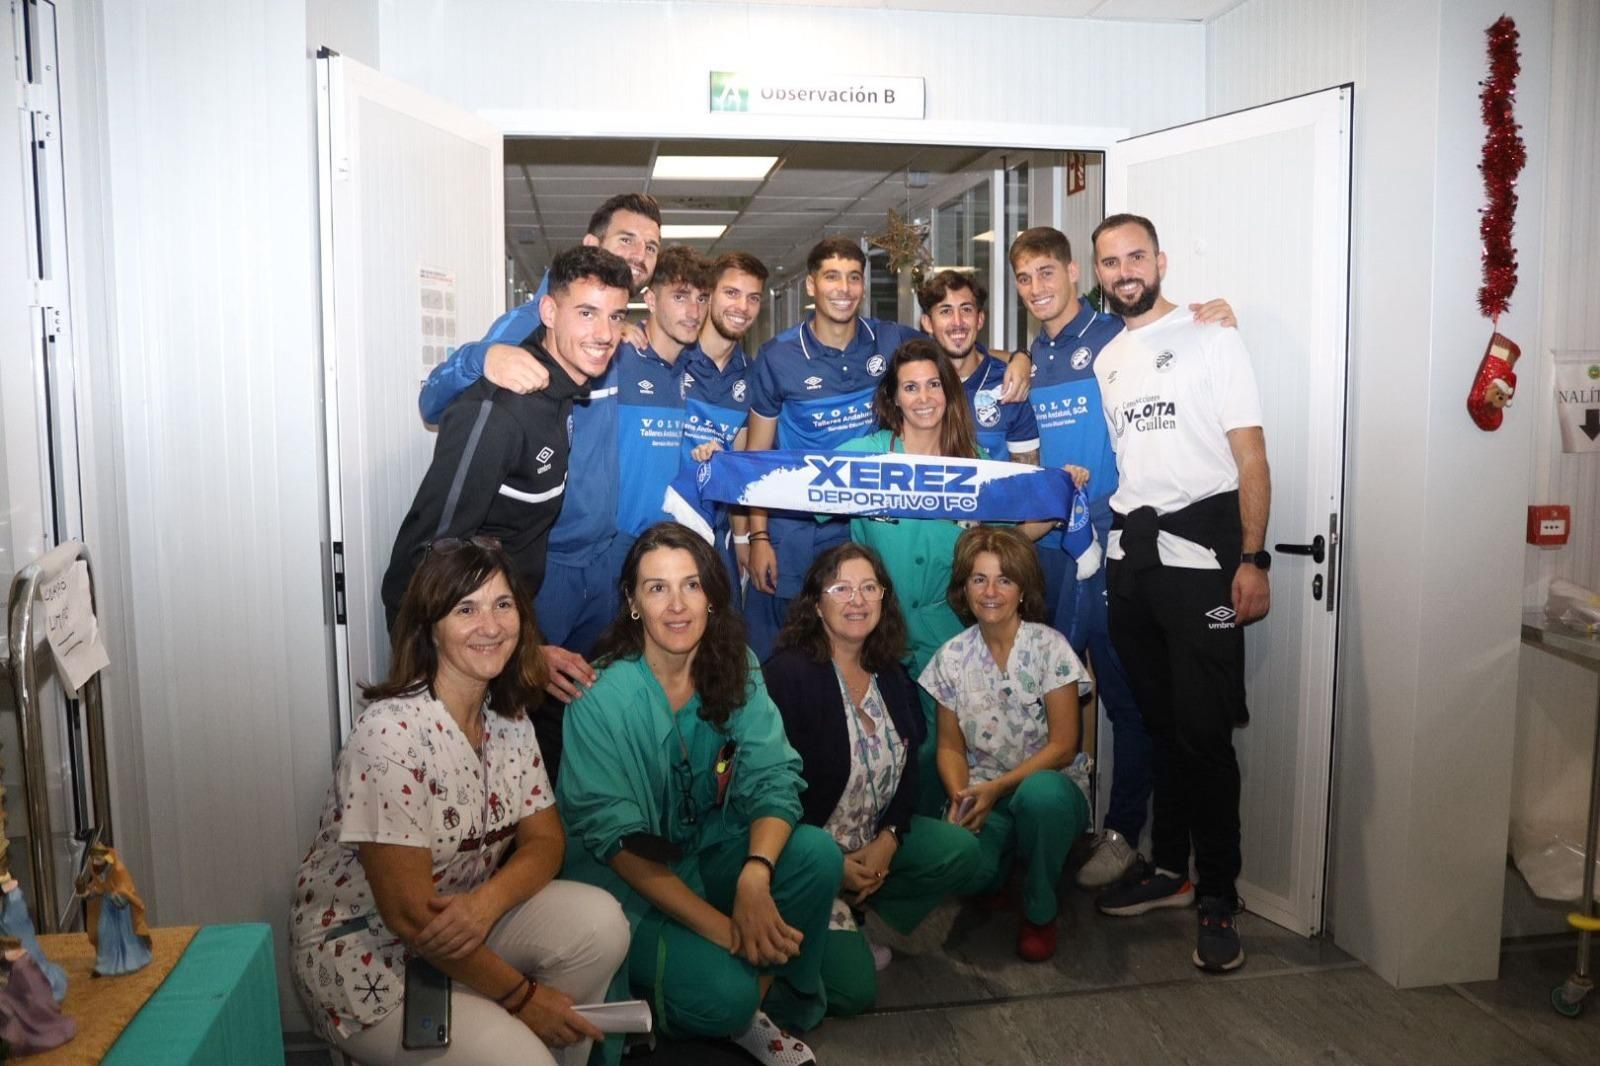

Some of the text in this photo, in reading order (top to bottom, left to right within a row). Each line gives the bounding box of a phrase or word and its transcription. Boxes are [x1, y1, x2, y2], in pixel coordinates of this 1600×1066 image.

[761, 86, 896, 104] Observación B
[811, 401, 874, 420] VOLV
[808, 458, 978, 494] XEREZ
[808, 489, 976, 509] DEPORTIVO FC
[1208, 622, 1236, 630] umbro
